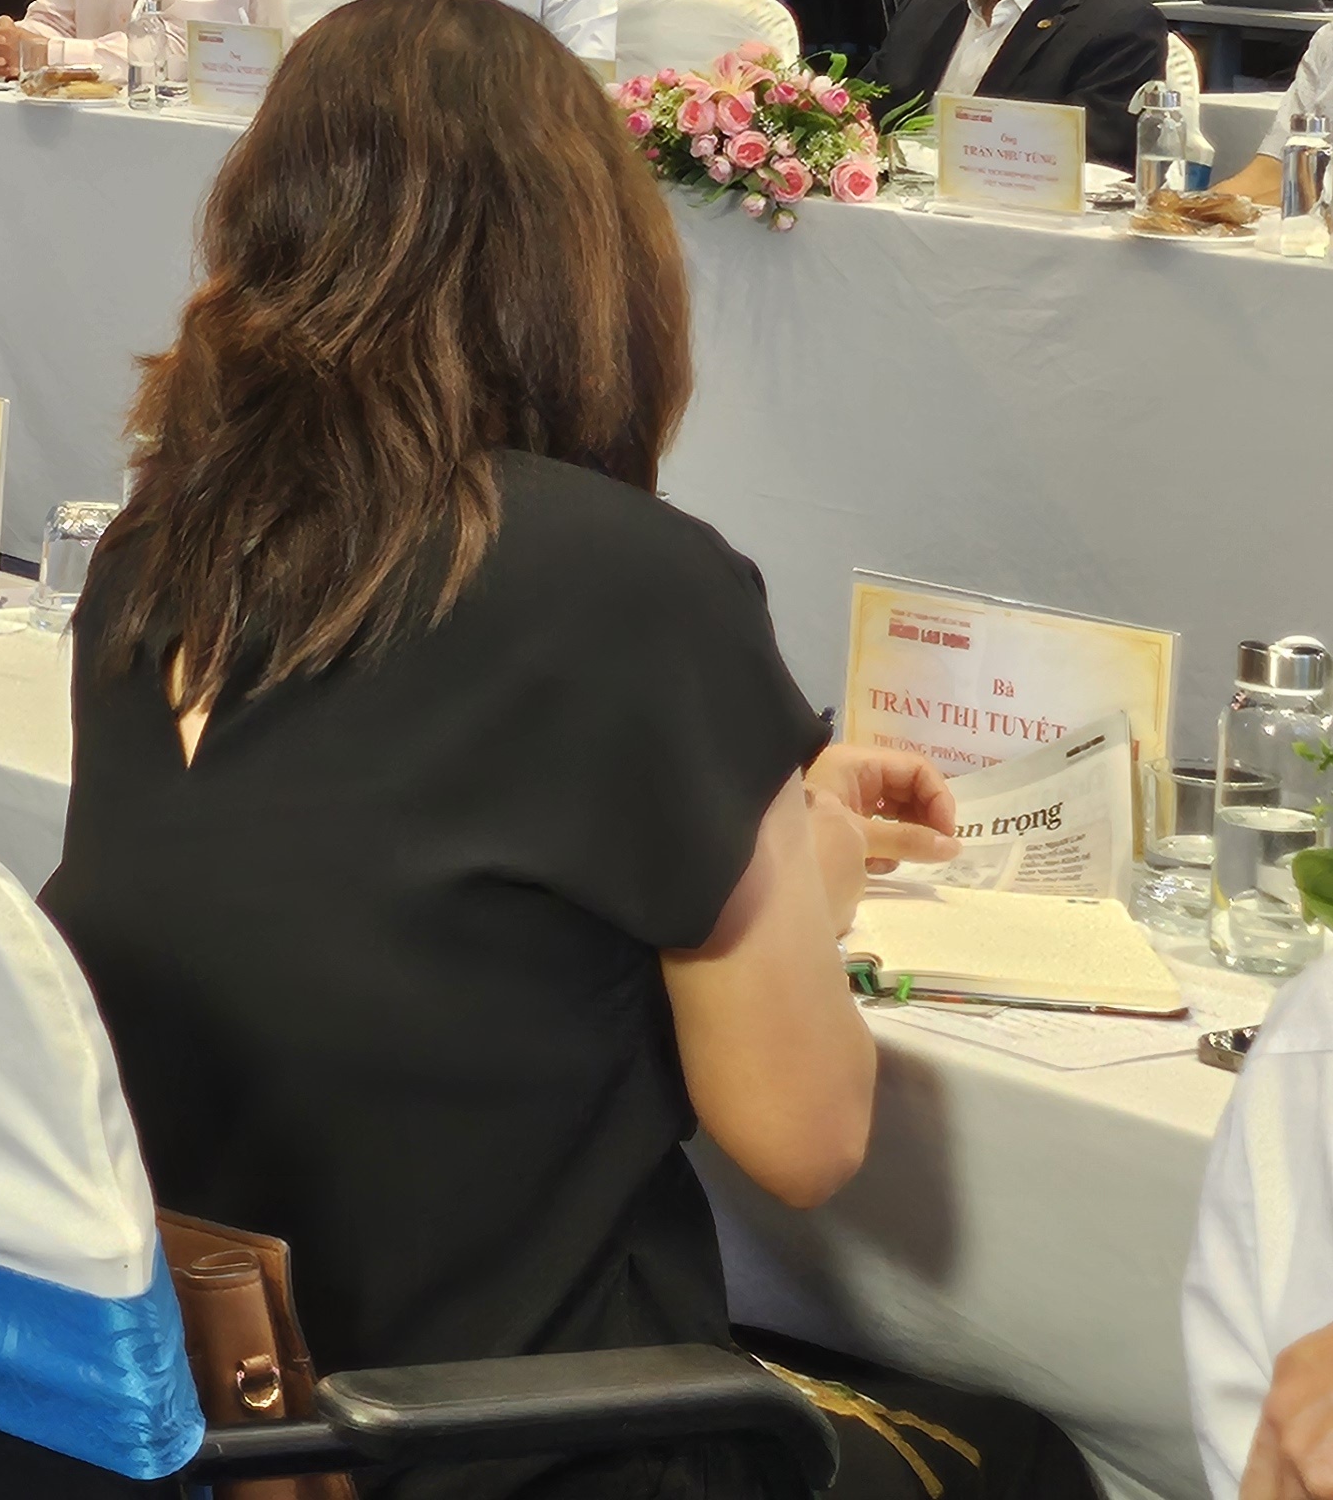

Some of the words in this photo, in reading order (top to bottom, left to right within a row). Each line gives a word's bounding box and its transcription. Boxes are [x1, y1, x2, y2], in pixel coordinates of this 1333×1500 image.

[992, 677, 1015, 698] Bà
[869, 688, 931, 719] TRẦN
[937, 700, 978, 735] THỊ
[991, 801, 1064, 836] trọng
